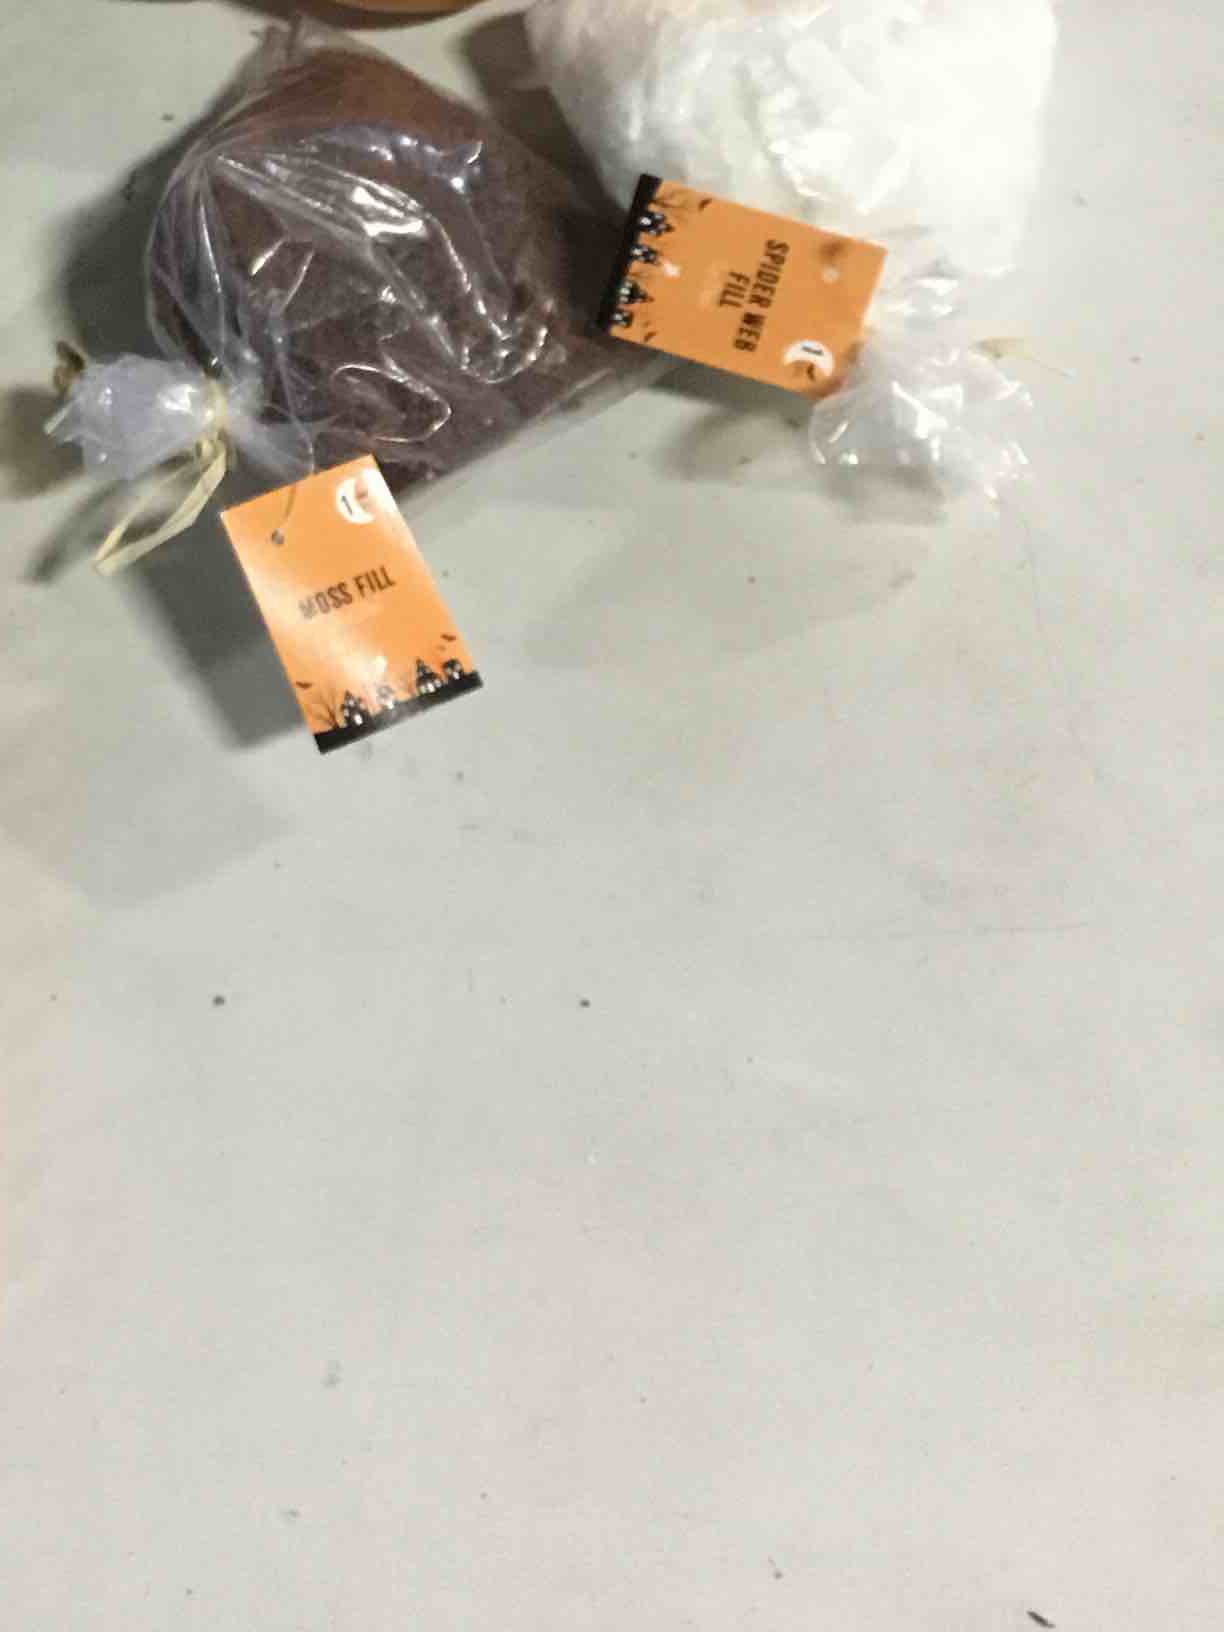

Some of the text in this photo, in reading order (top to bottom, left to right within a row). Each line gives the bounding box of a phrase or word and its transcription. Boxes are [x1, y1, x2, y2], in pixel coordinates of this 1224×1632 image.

[718, 270, 751, 308] FILL
[733, 240, 790, 352] SPIDER WEB
[299, 564, 396, 620] MOSS FILL
